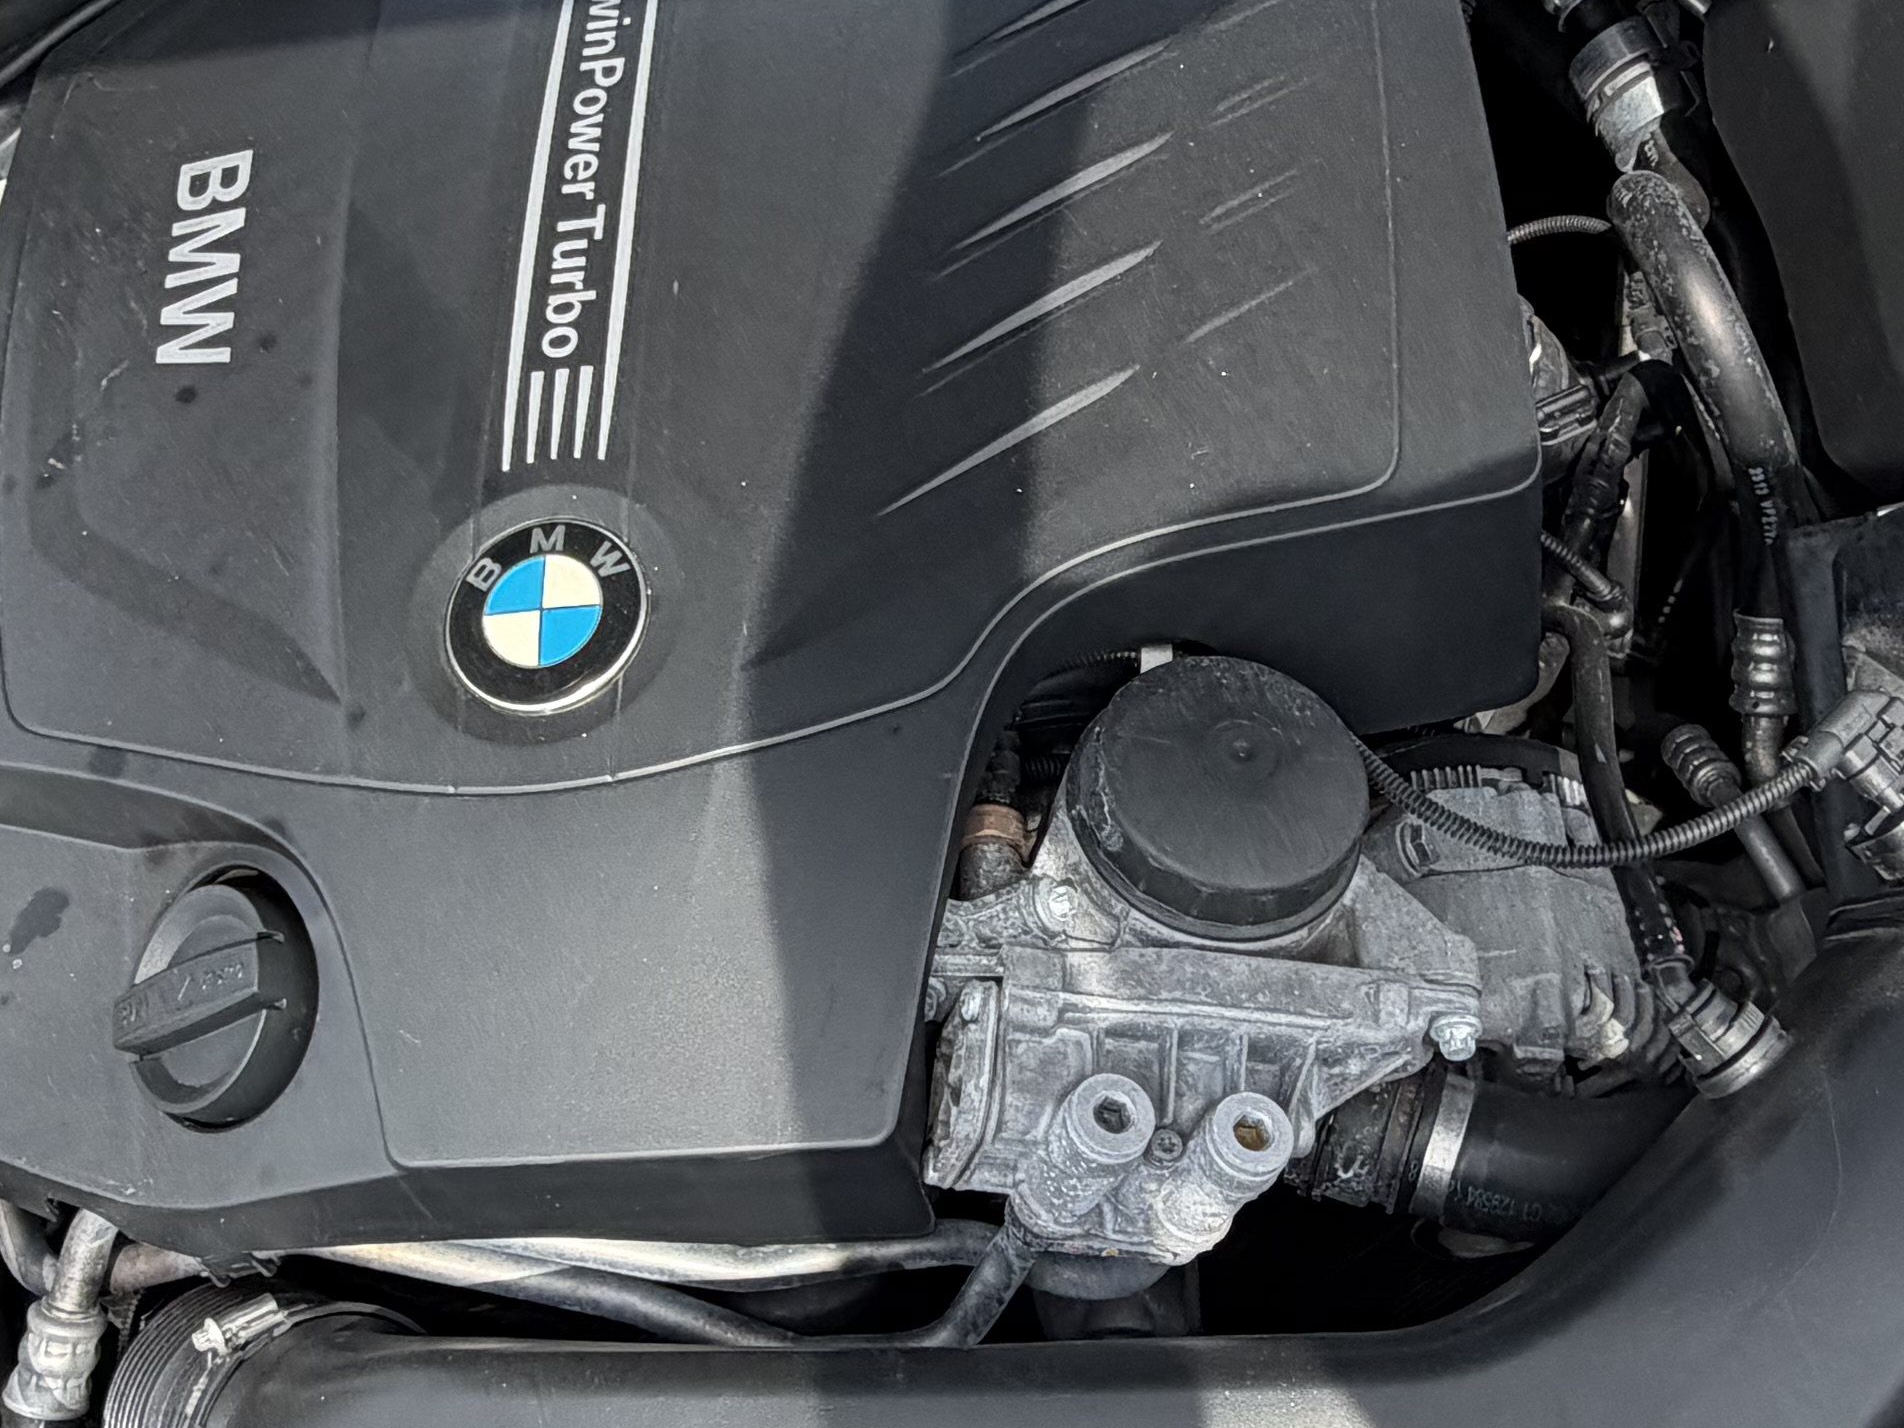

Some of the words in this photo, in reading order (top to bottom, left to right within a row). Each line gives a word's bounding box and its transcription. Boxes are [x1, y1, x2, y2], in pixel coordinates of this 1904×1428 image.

[155, 148, 254, 364] BMW
[541, 203, 607, 359] Turbo
[465, 524, 632, 593] BMW
